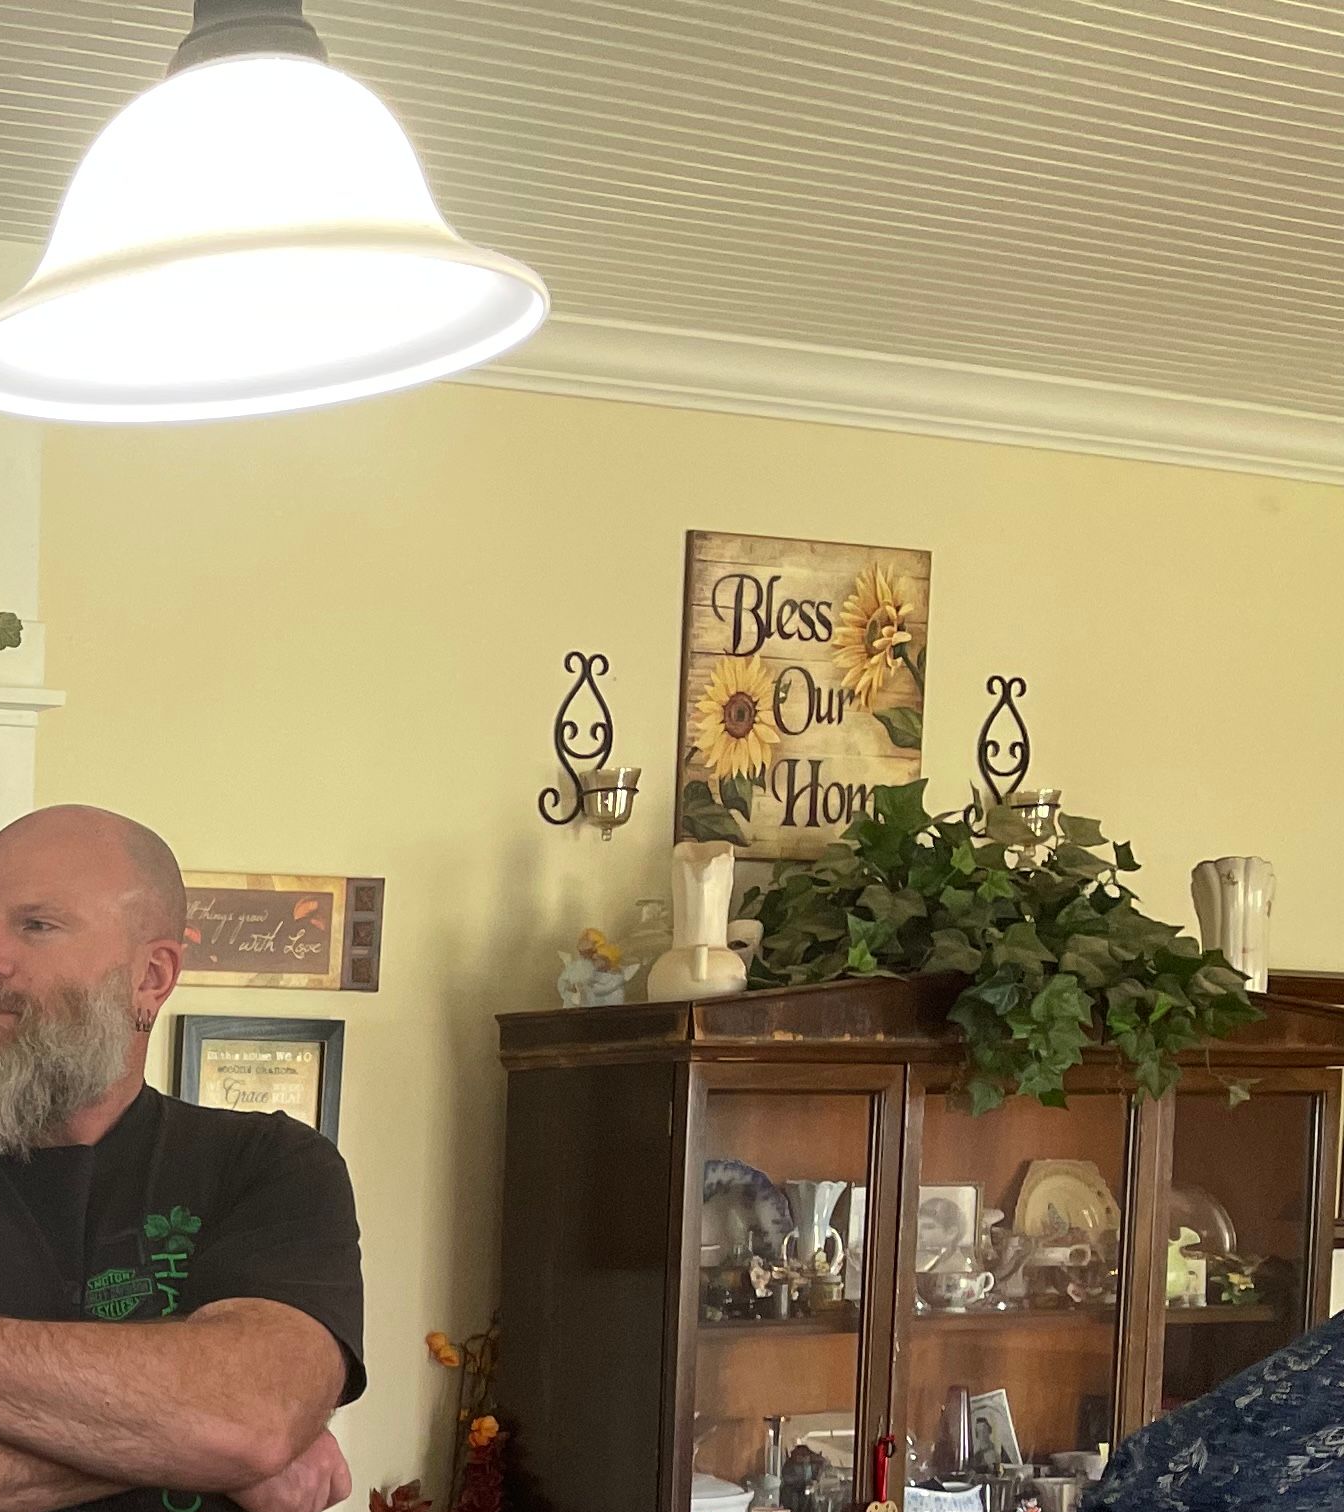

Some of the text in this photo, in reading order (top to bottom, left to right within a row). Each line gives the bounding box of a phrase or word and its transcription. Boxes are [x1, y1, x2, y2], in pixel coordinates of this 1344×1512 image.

[713, 573, 833, 657] Bless
[772, 666, 862, 736] Our
[769, 758, 878, 829] Hom
[238, 920, 322, 960] with Love
[223, 1077, 269, 1109] Grace
